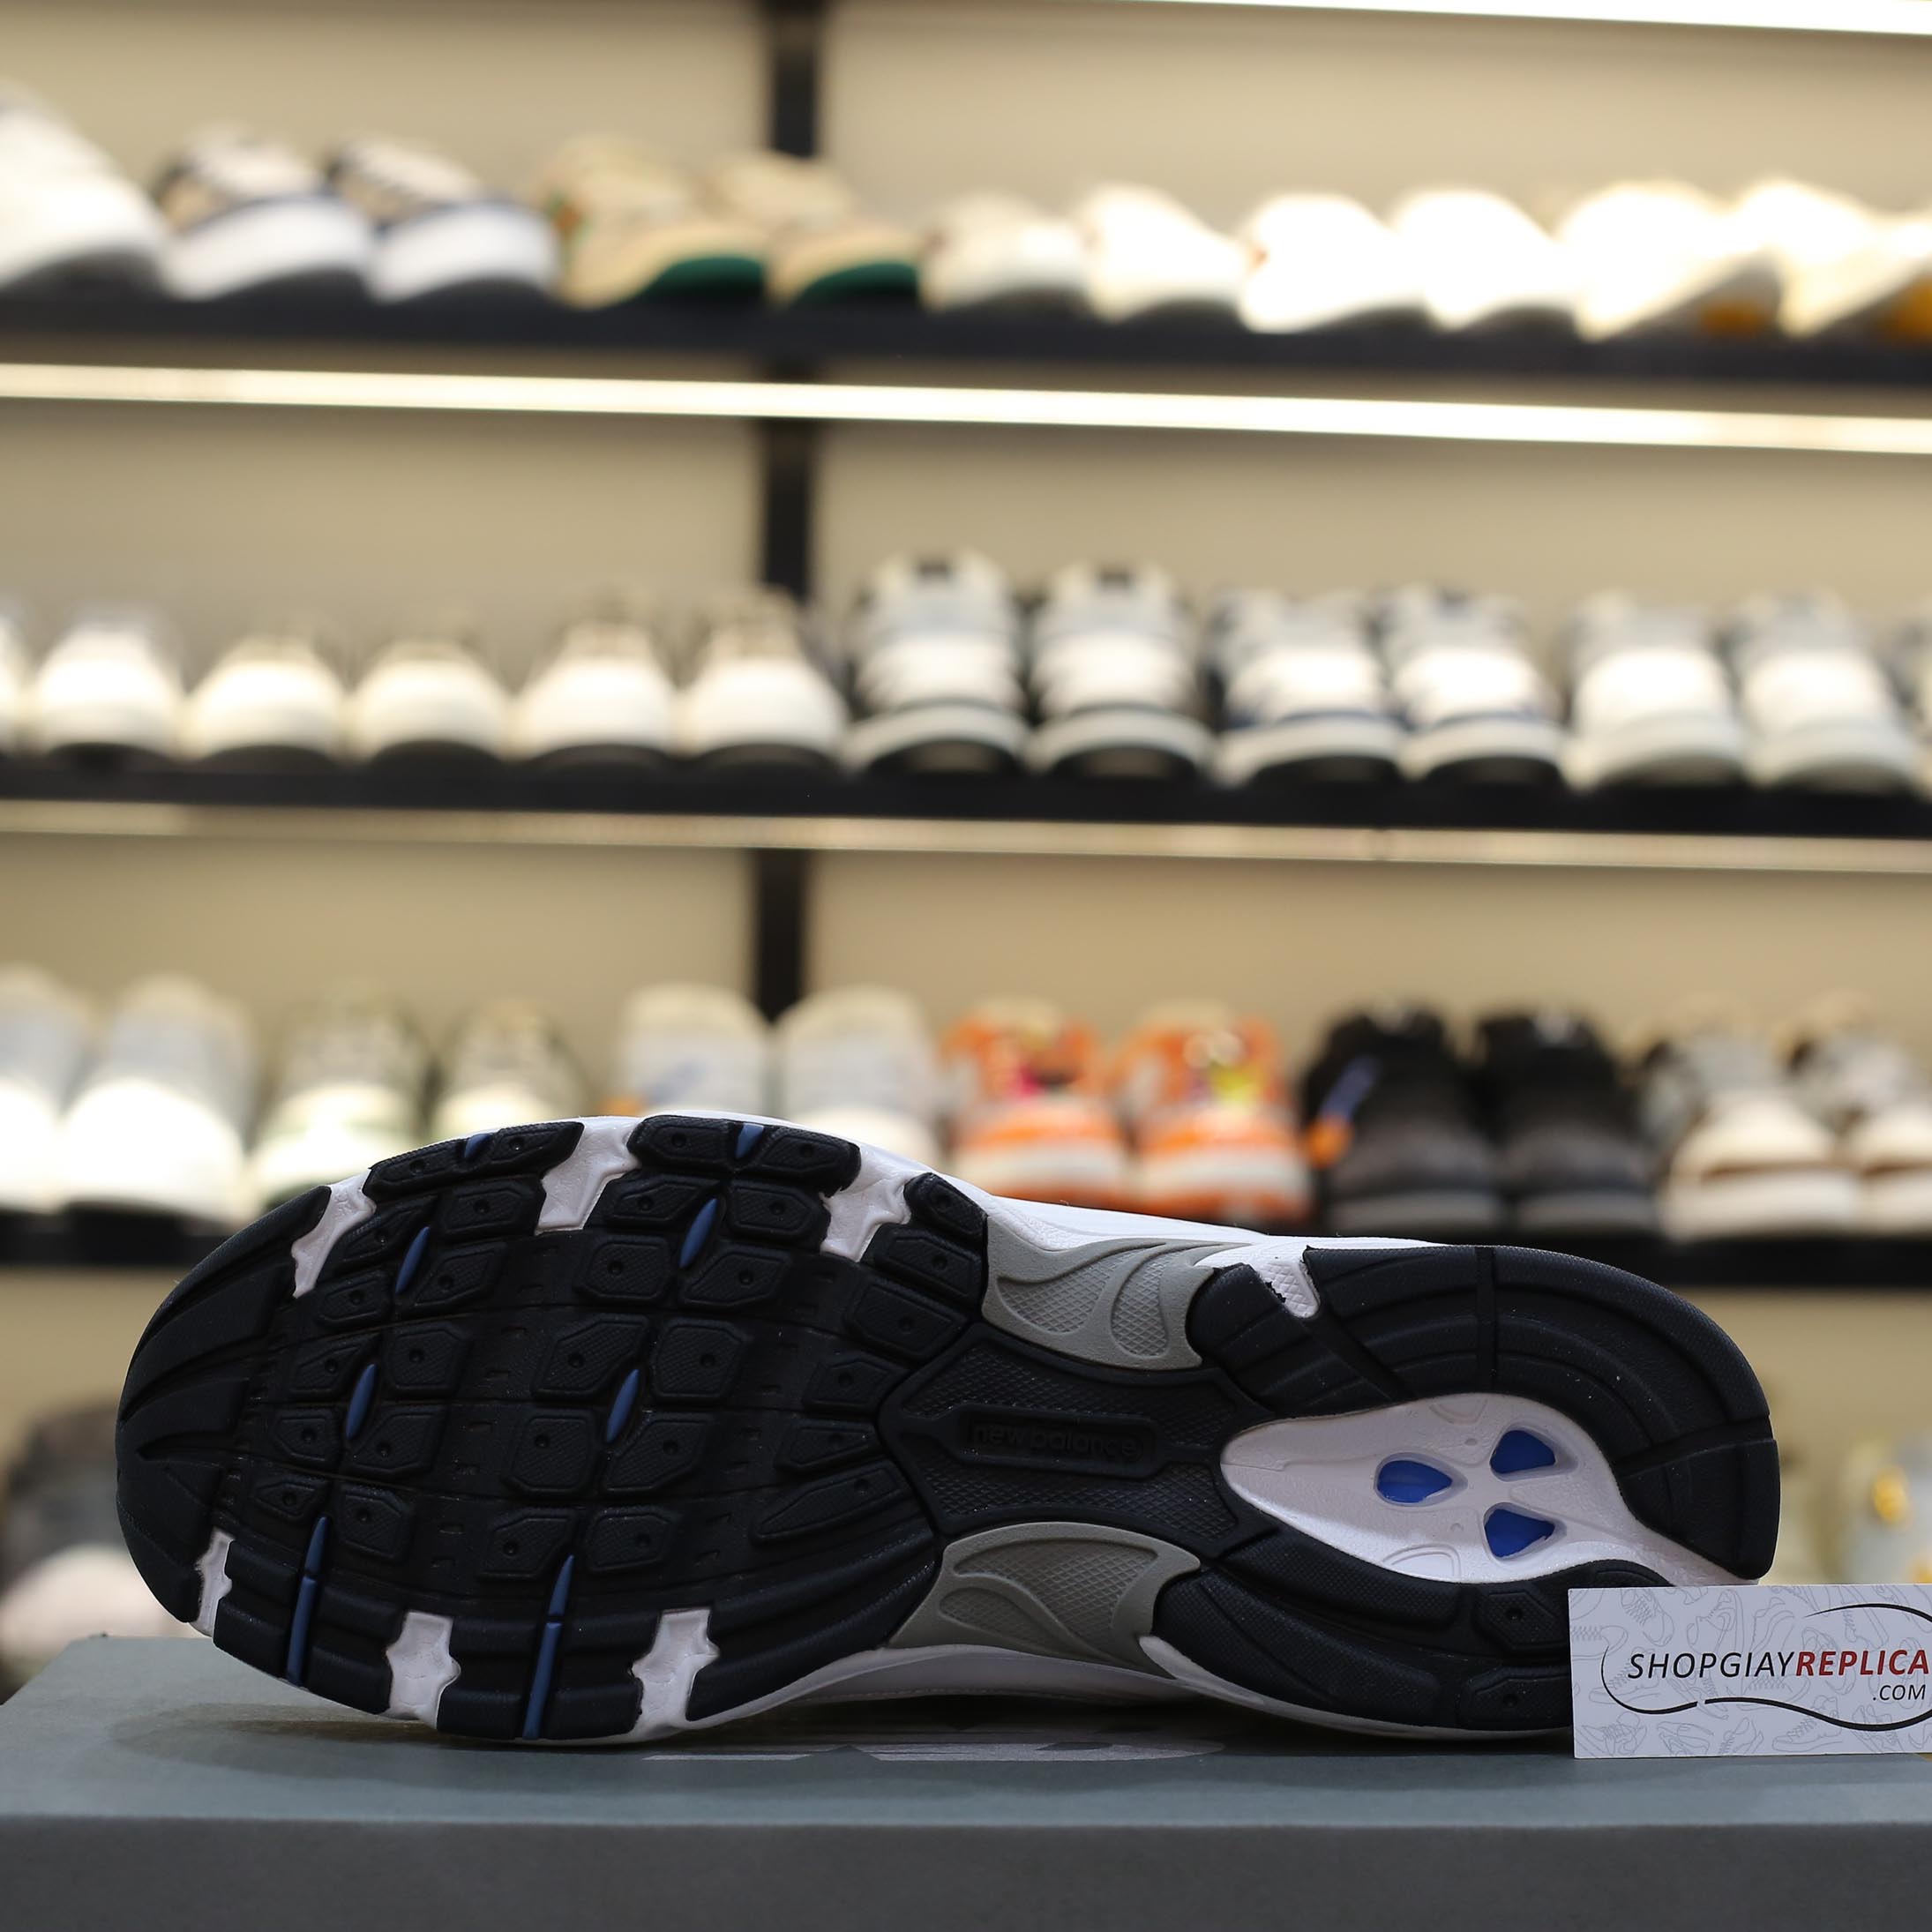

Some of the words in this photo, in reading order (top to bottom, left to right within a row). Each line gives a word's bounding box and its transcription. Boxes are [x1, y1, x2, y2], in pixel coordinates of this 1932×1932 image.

[973, 1425, 1027, 1447] new
[1030, 1424, 1143, 1460] balance
[1628, 1650, 1929, 1680] SHOPGIAYREPLICA
[1872, 1683, 1927, 1702] .COM
